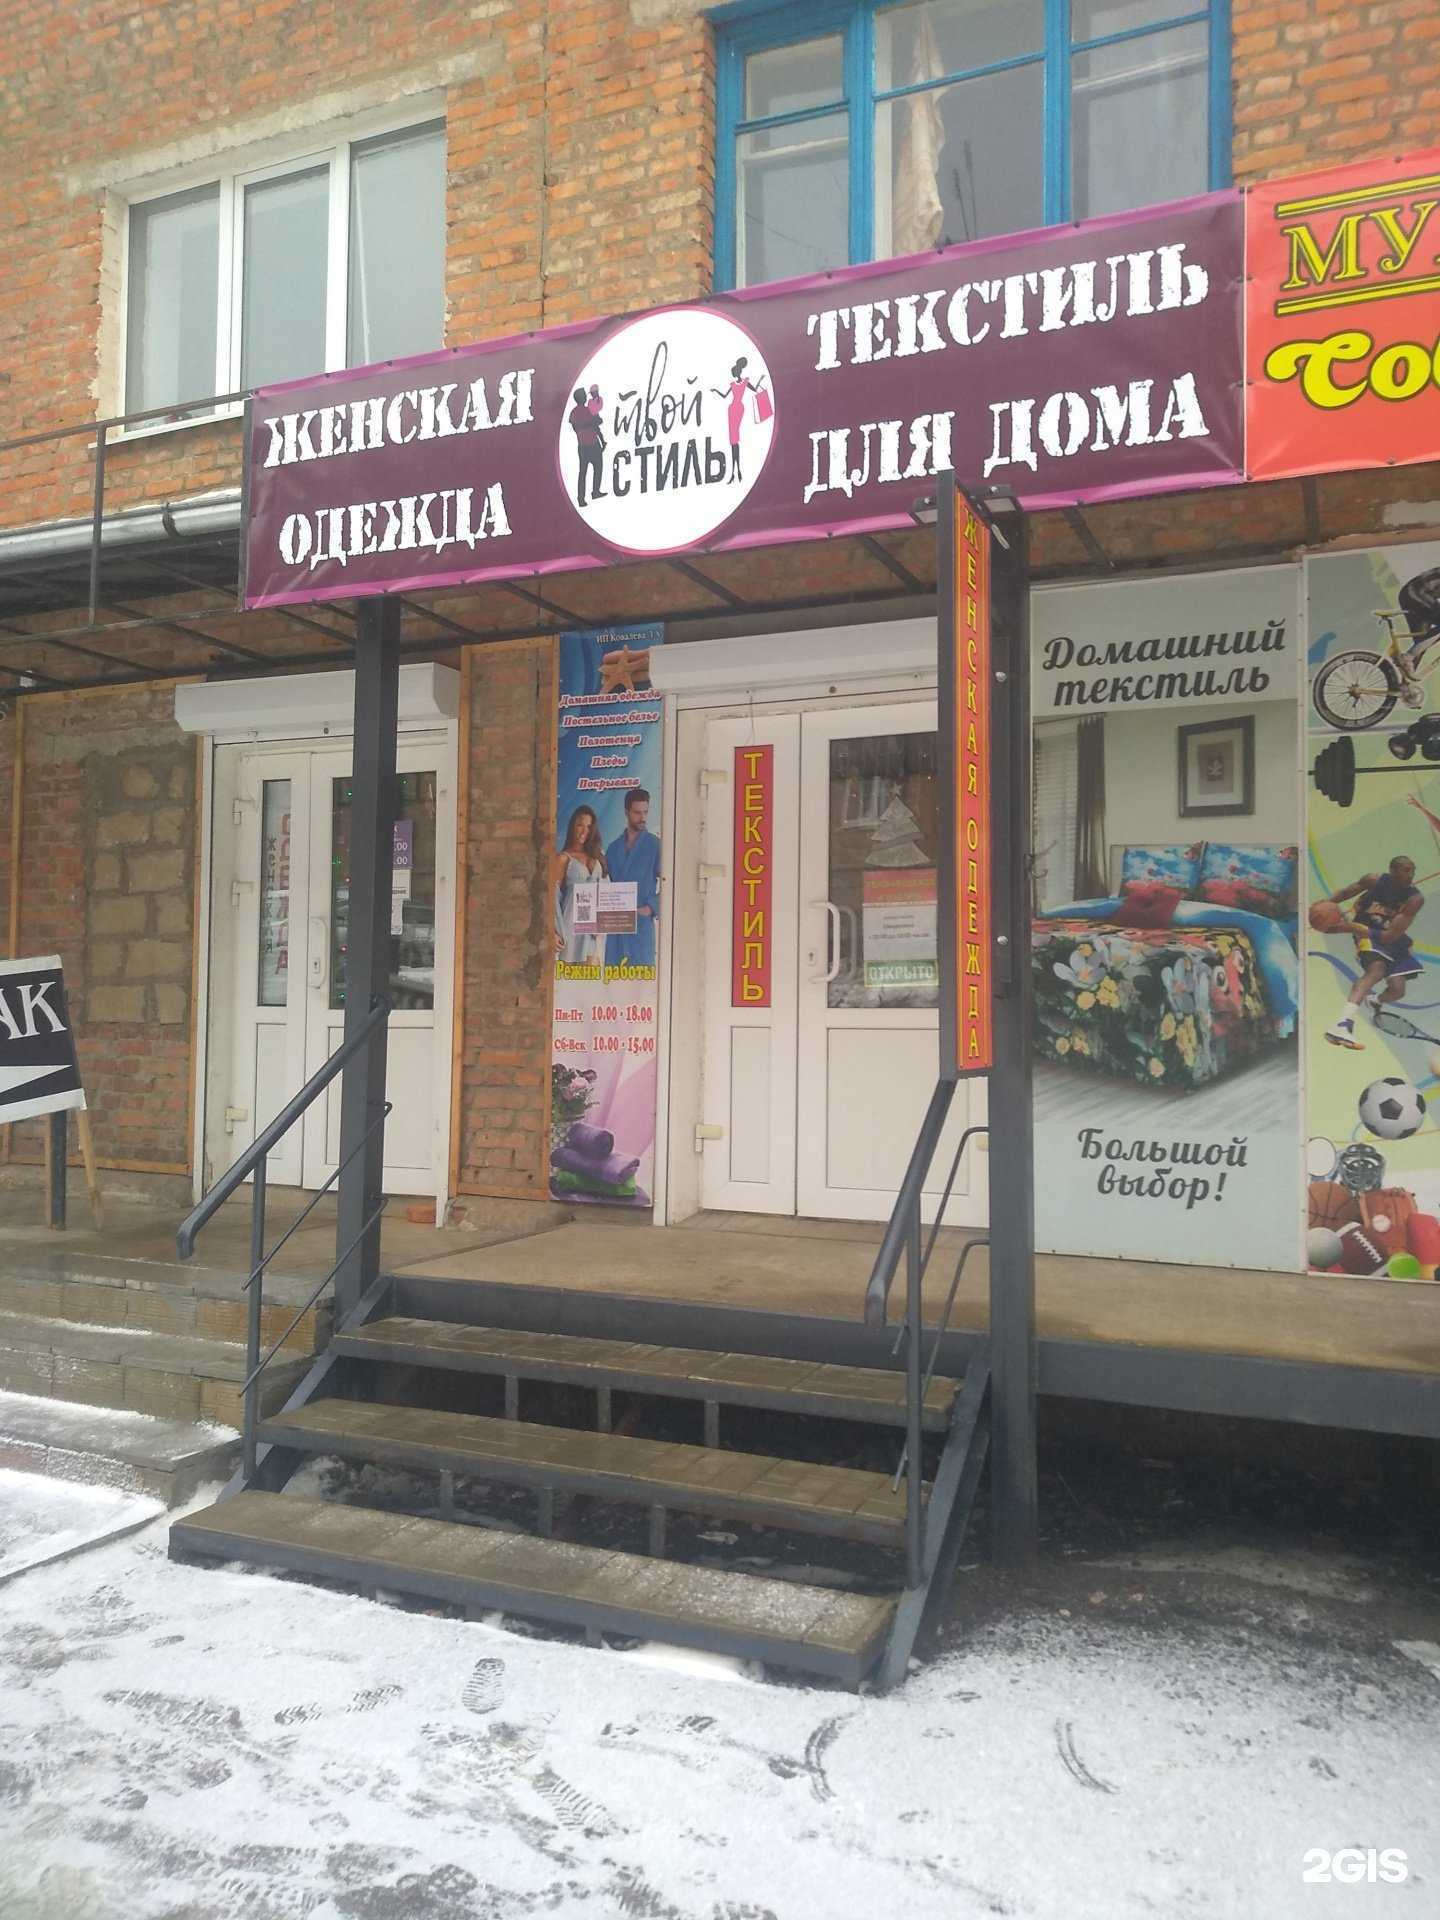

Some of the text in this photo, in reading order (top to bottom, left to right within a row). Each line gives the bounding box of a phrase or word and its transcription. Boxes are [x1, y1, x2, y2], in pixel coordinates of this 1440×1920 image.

[1281, 199, 1440, 290] МУ
[807, 243, 1209, 371] ТЕКСТИЛЬ
[1264, 328, 1440, 410] Со
[614, 341, 702, 447] твой
[263, 368, 535, 468] ЖЕНСКАЯ
[803, 372, 1210, 504] ДЛЯ ДОМА
[279, 482, 512, 570] ОДЕЖДА
[1042, 618, 1286, 670] Домашний
[619, 688, 661, 703] одежда
[1054, 667, 1270, 706] текстиль
[563, 714, 627, 727] Постельное
[578, 734, 641, 748] Полотенца
[591, 755, 628, 768] Пледы
[577, 777, 640, 791] Покрывала
[742, 752, 764, 1001] ТЕКСТИЛЬ
[555, 957, 656, 984] Режим работы
[869, 966, 934, 981] ОТКРЫТО
[591, 1006, 617, 1021] 10.00
[593, 1037, 619, 1051] 10.00
[1078, 1128, 1247, 1167] Большой
[1097, 1164, 1227, 1209] выбор!
